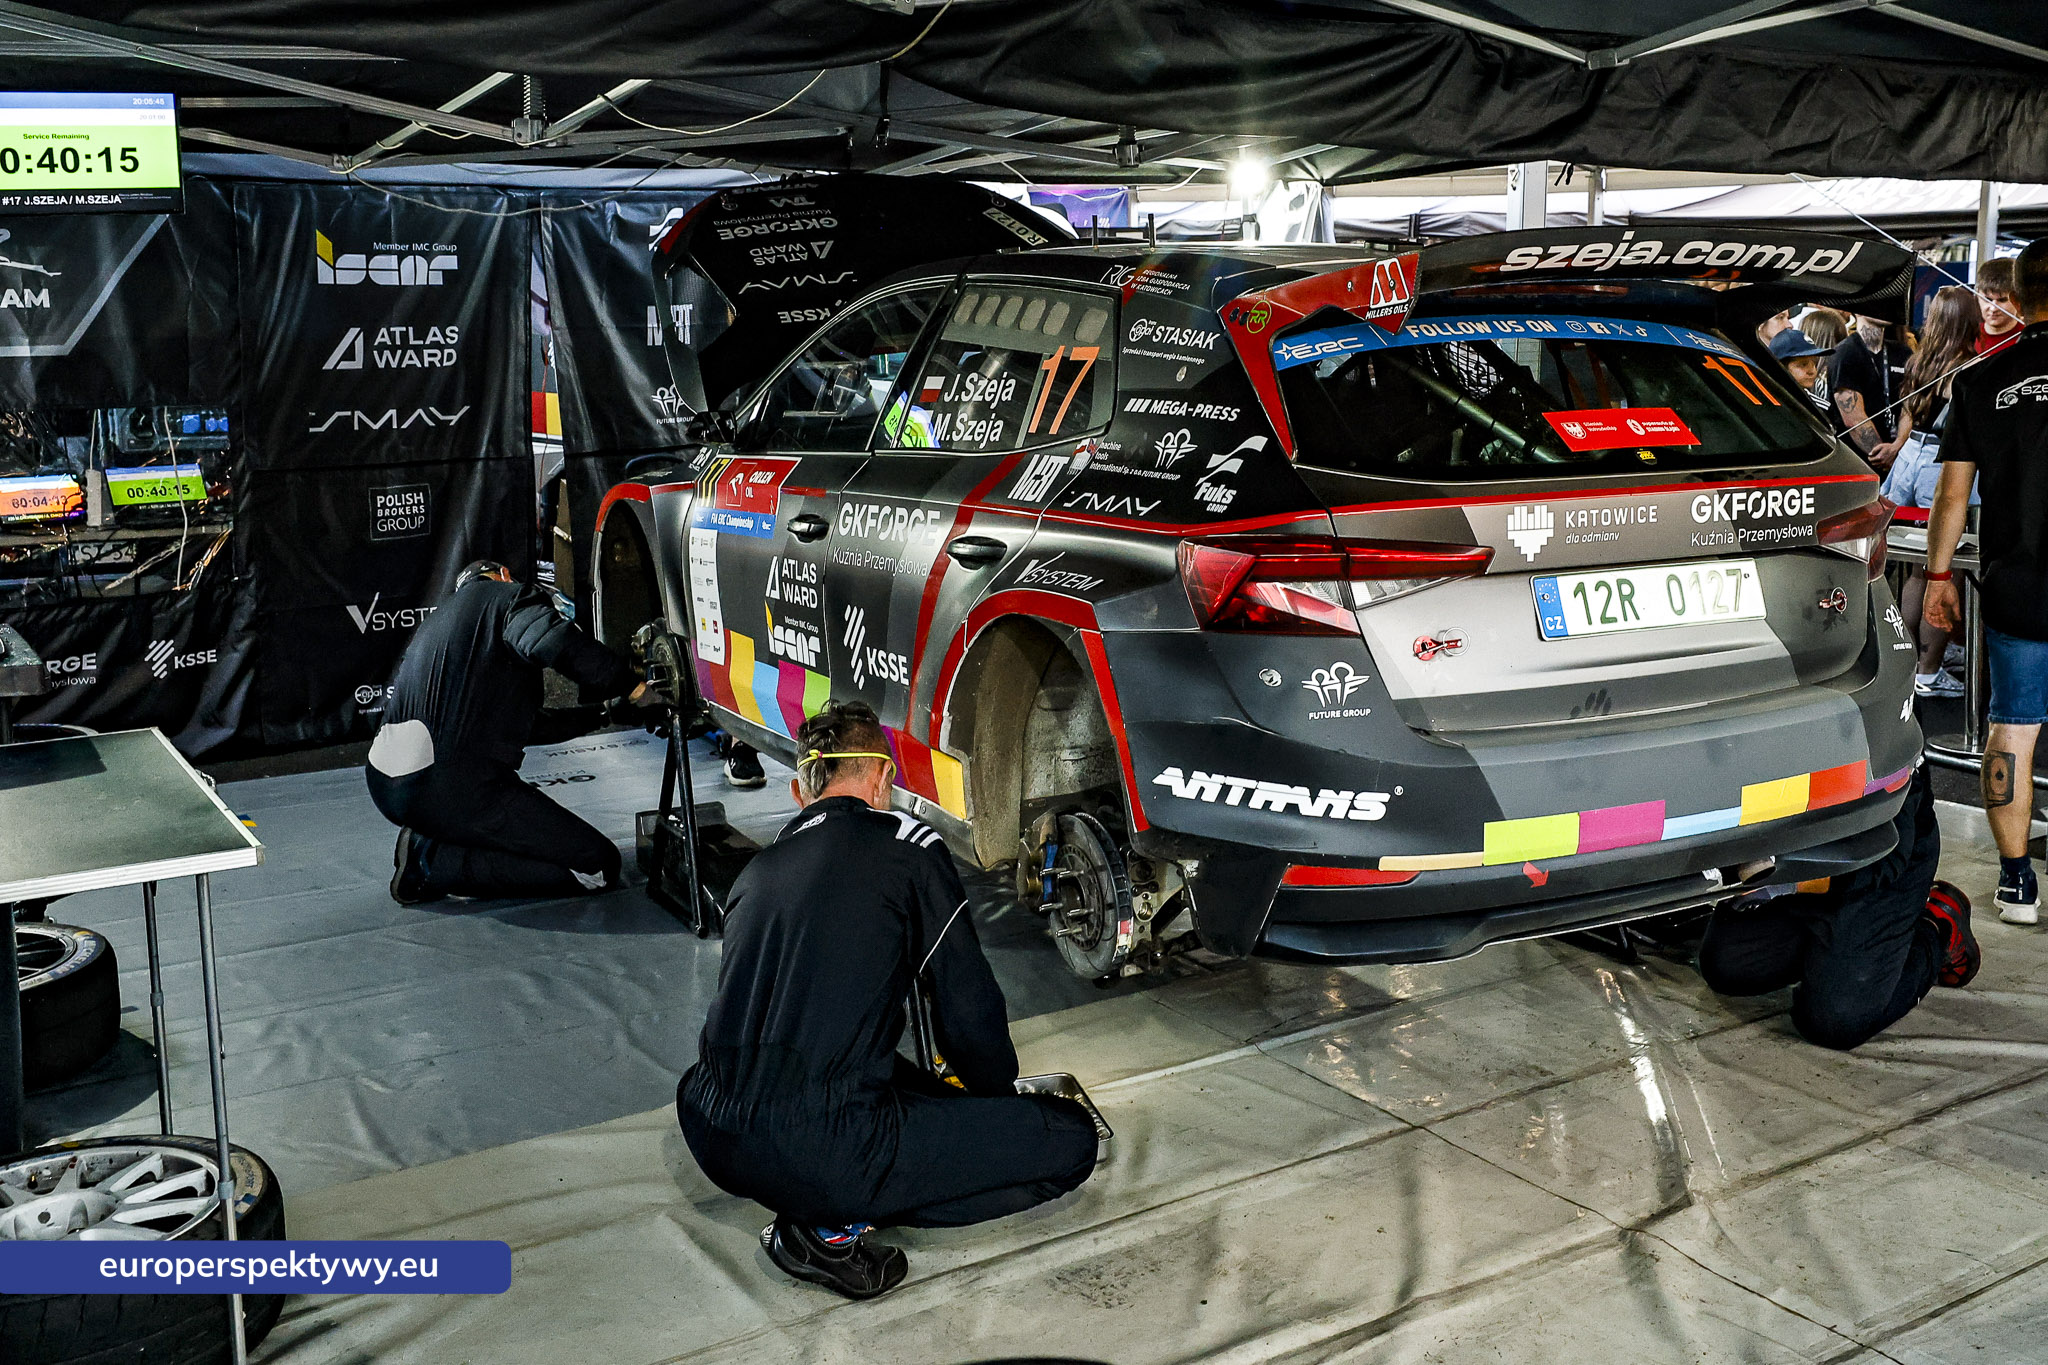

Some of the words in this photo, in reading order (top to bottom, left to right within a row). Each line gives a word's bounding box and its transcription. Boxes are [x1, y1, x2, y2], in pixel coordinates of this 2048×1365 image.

[22, 133, 50, 141] Service
[51, 133, 90, 142] Remaining
[2, 196, 22, 206] #17
[24, 195, 68, 206] J.SZEJA
[75, 194, 122, 205] M.SZEJA
[716, 216, 839, 241] GKFORGE
[373, 241, 410, 251] Member
[412, 242, 430, 251] IMC
[432, 243, 458, 252] Group
[749, 243, 807, 257] WARD
[1499, 230, 1865, 277] szeja.com.pl
[753, 251, 809, 267] ATLAS
[777, 307, 832, 324] KSSE
[1364, 306, 1393, 321] MILLERS
[1392, 302, 1410, 316] OILS
[373, 326, 460, 346] ATLAS
[1152, 325, 1221, 350] STASIAK
[1405, 321, 1493, 339] FOLLOW
[1493, 320, 1520, 334] US
[1520, 319, 1558, 333] ON
[373, 348, 458, 369] WARD
[1701, 354, 1782, 406] 17
[943, 371, 1017, 410] J.Szeja
[1027, 345, 1101, 436] 17
[1148, 399, 1241, 422] MEGA-PRESS
[934, 410, 1005, 450] M.Szeja
[748, 470, 776, 485] ORLEN
[1141, 470, 1163, 480] FUTURE
[1161, 472, 1182, 482] GROUP
[126, 483, 192, 500] 00:40:15
[376, 491, 425, 508] POLISH
[744, 486, 754, 499] OIL
[1193, 482, 1238, 505] Fuks
[376, 504, 426, 518] BROKERS
[1205, 502, 1229, 515] GROUP
[1690, 487, 1816, 525] GKFORGE
[376, 515, 426, 533] GROUP
[726, 515, 754, 531] Championship
[838, 501, 942, 547] GKFORGE
[1564, 505, 1659, 529] KATOWICE
[1690, 530, 1735, 547] Kuźnia
[1737, 522, 1814, 545] Przemysłowa
[781, 557, 818, 585] ATLAS
[832, 546, 863, 567] Kuźnia
[863, 550, 929, 577] Przemysłowa
[782, 581, 819, 609] WARD
[1573, 577, 1641, 627] 12R
[1665, 567, 1742, 617] 0127
[784, 615, 800, 628] Member
[806, 622, 819, 635] Group
[1544, 615, 1565, 631] CZ
[174, 649, 218, 670] KSSE
[866, 646, 910, 686] KSSE
[1308, 708, 1341, 721] FUTURE
[1341, 706, 1372, 719] GROUP
